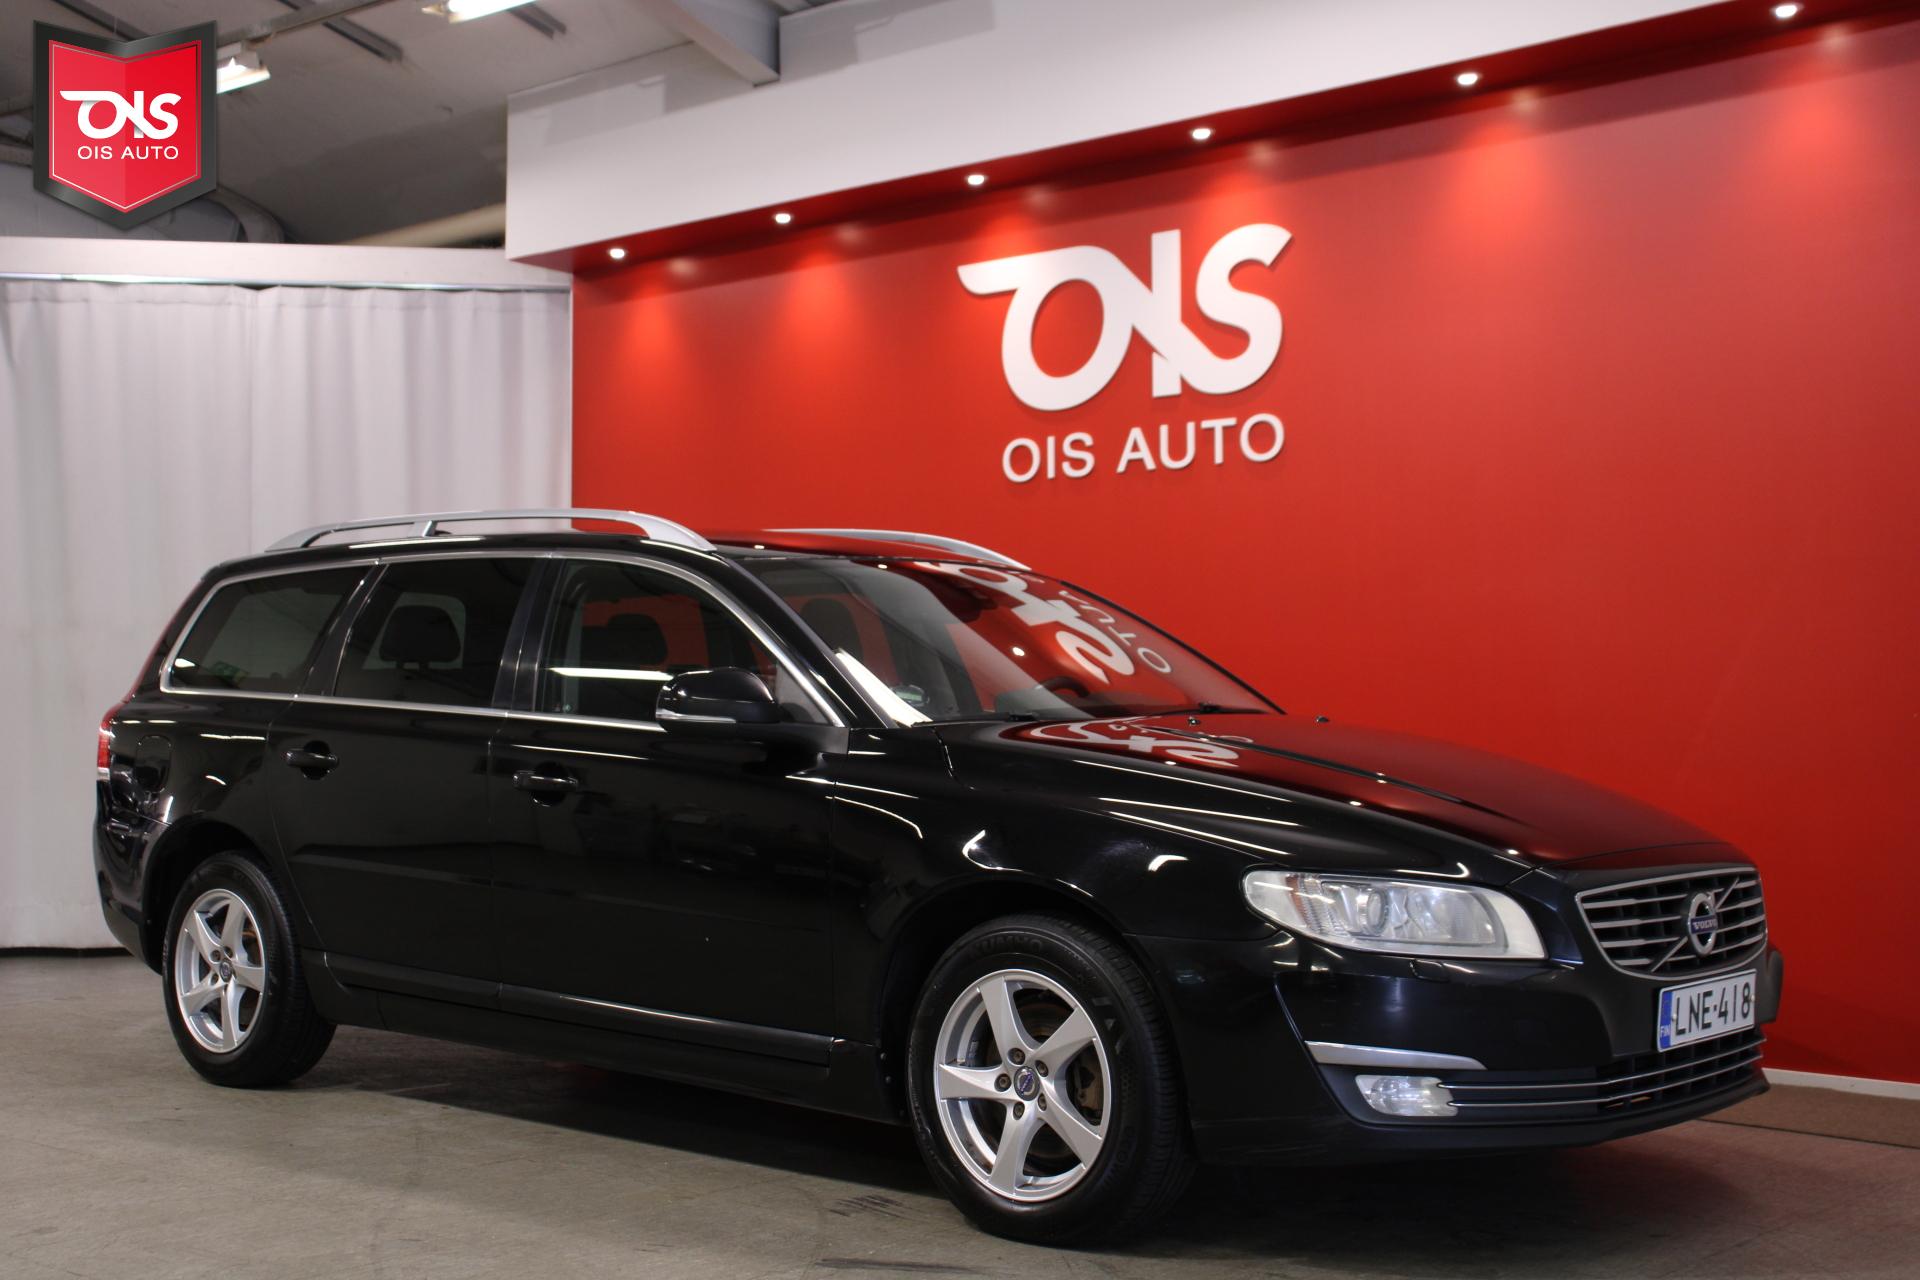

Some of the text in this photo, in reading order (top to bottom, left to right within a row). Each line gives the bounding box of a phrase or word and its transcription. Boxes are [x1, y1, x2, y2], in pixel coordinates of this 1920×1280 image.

[1002, 413, 1285, 483] OIS AUTO
[1675, 982, 1751, 1036] LNE-418
